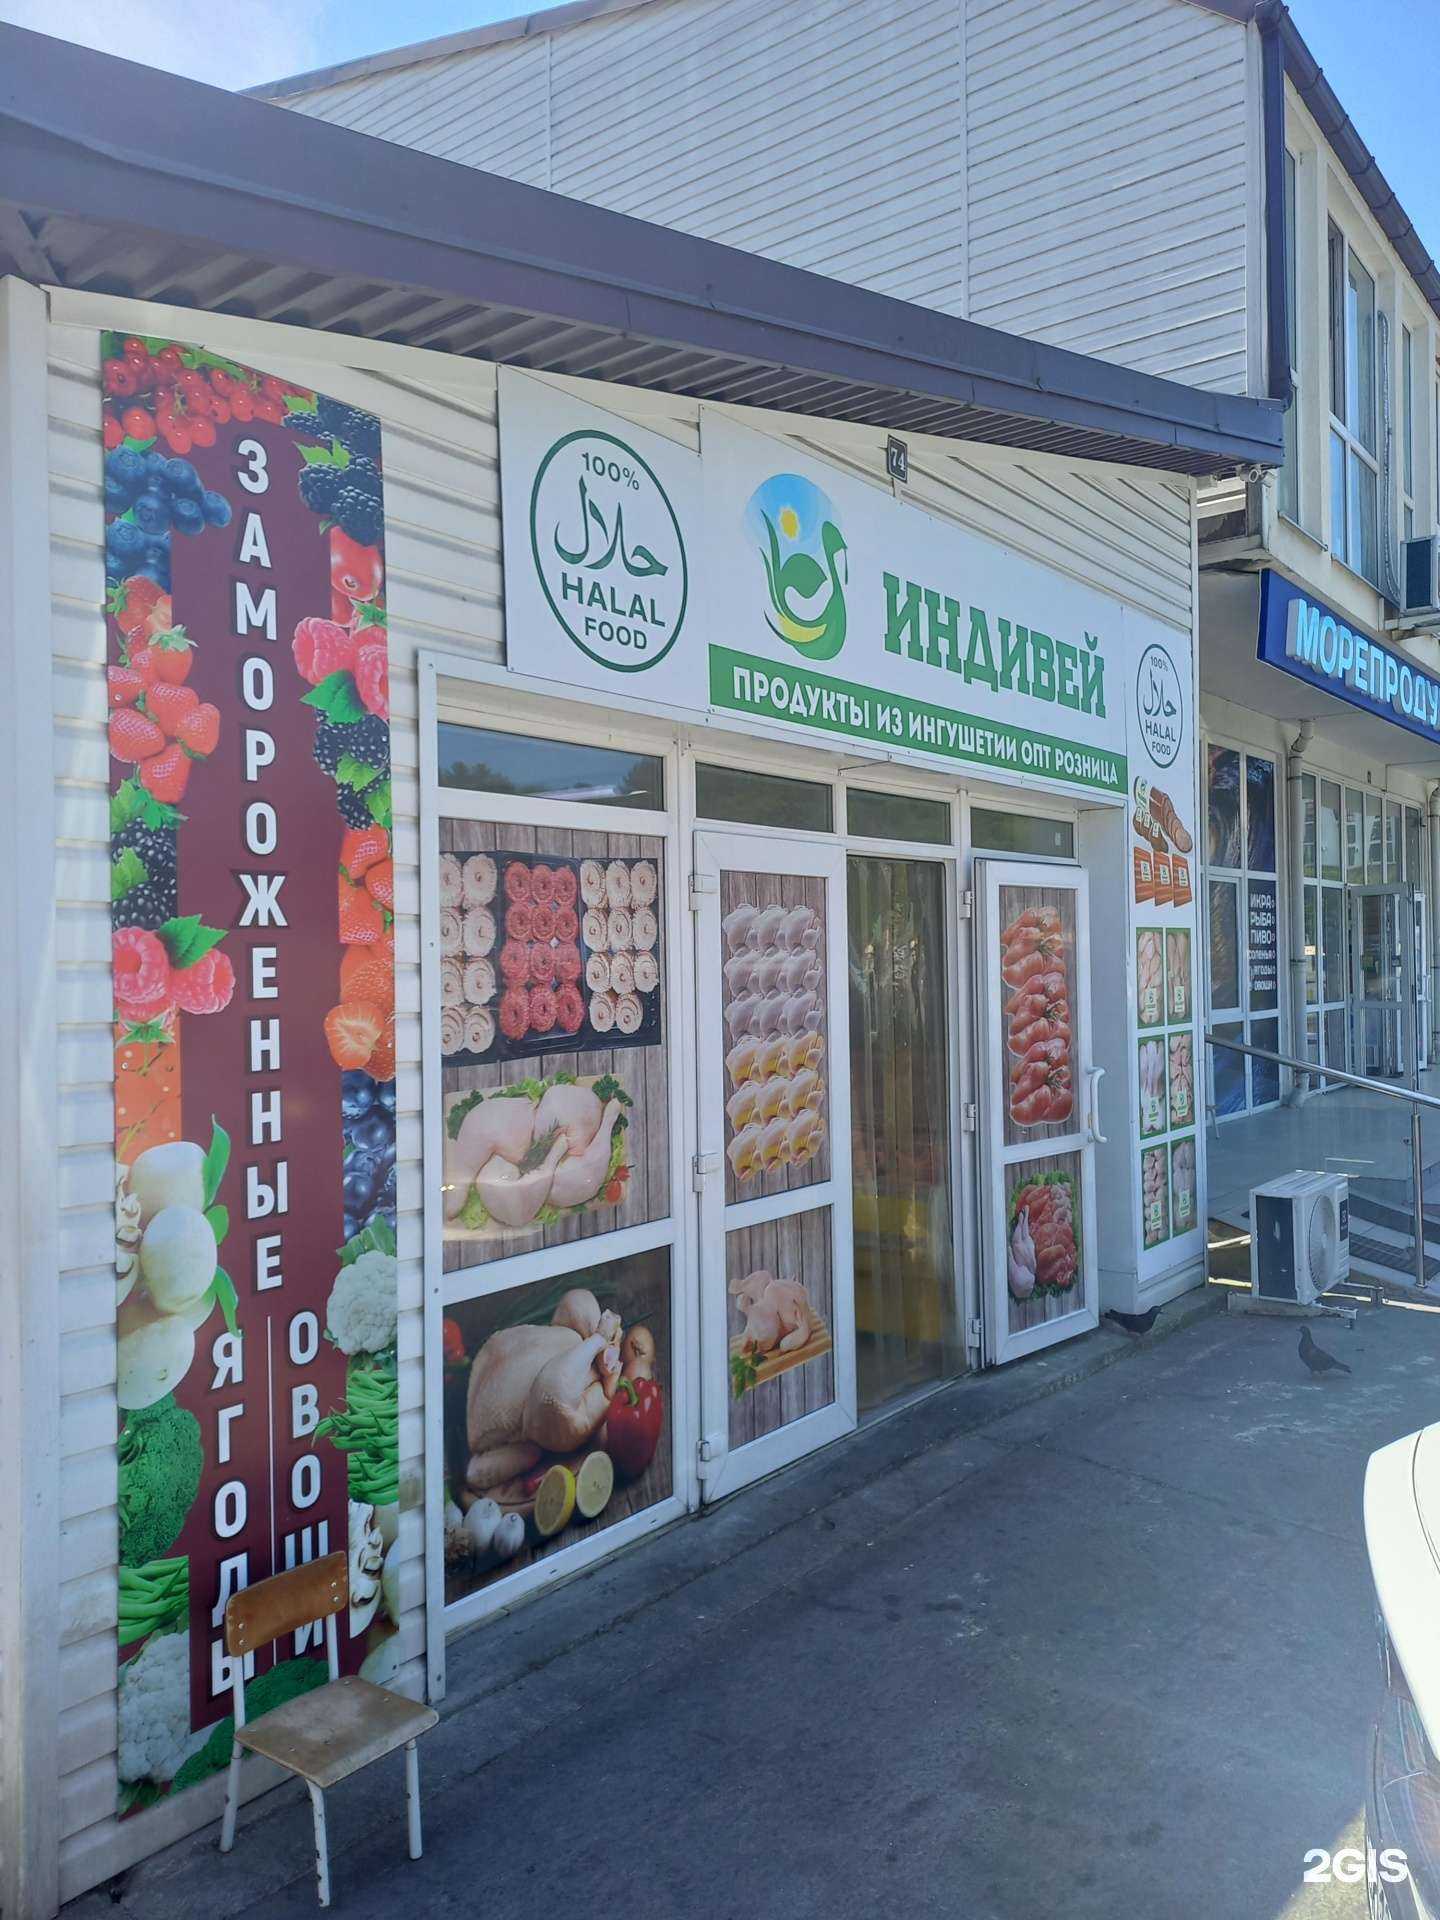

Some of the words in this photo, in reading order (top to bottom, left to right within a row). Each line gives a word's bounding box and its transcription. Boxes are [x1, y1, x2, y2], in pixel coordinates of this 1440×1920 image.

[582, 452, 640, 490] 100%
[890, 447, 906, 472] 74
[553, 474, 669, 577] حلال
[561, 571, 666, 628] HALAL
[584, 616, 647, 650] FOOD
[883, 571, 1106, 719] ИНДИВЕЙ
[1150, 656, 1168, 672] 100%
[1290, 598, 1440, 728] МОРЕПРОДУ
[1142, 667, 1177, 717] حلال
[733, 666, 870, 729] ПРОДУКТЫ
[877, 703, 903, 736] ИЗ
[908, 711, 1017, 762] ИНГУШЕТИИ
[1021, 740, 1051, 769] ОПТ
[1055, 748, 1118, 785] РОЗНИЦА
[1145, 719, 1176, 742] HALAL
[1151, 741, 1171, 756] FOOD
[235, 439, 288, 1291] ЗАМОРОЖЕННЫЕ
[1250, 893, 1271, 909] ИКРА
[1250, 911, 1271, 927] РЫБА
[1250, 929, 1272, 945] ПИВО
